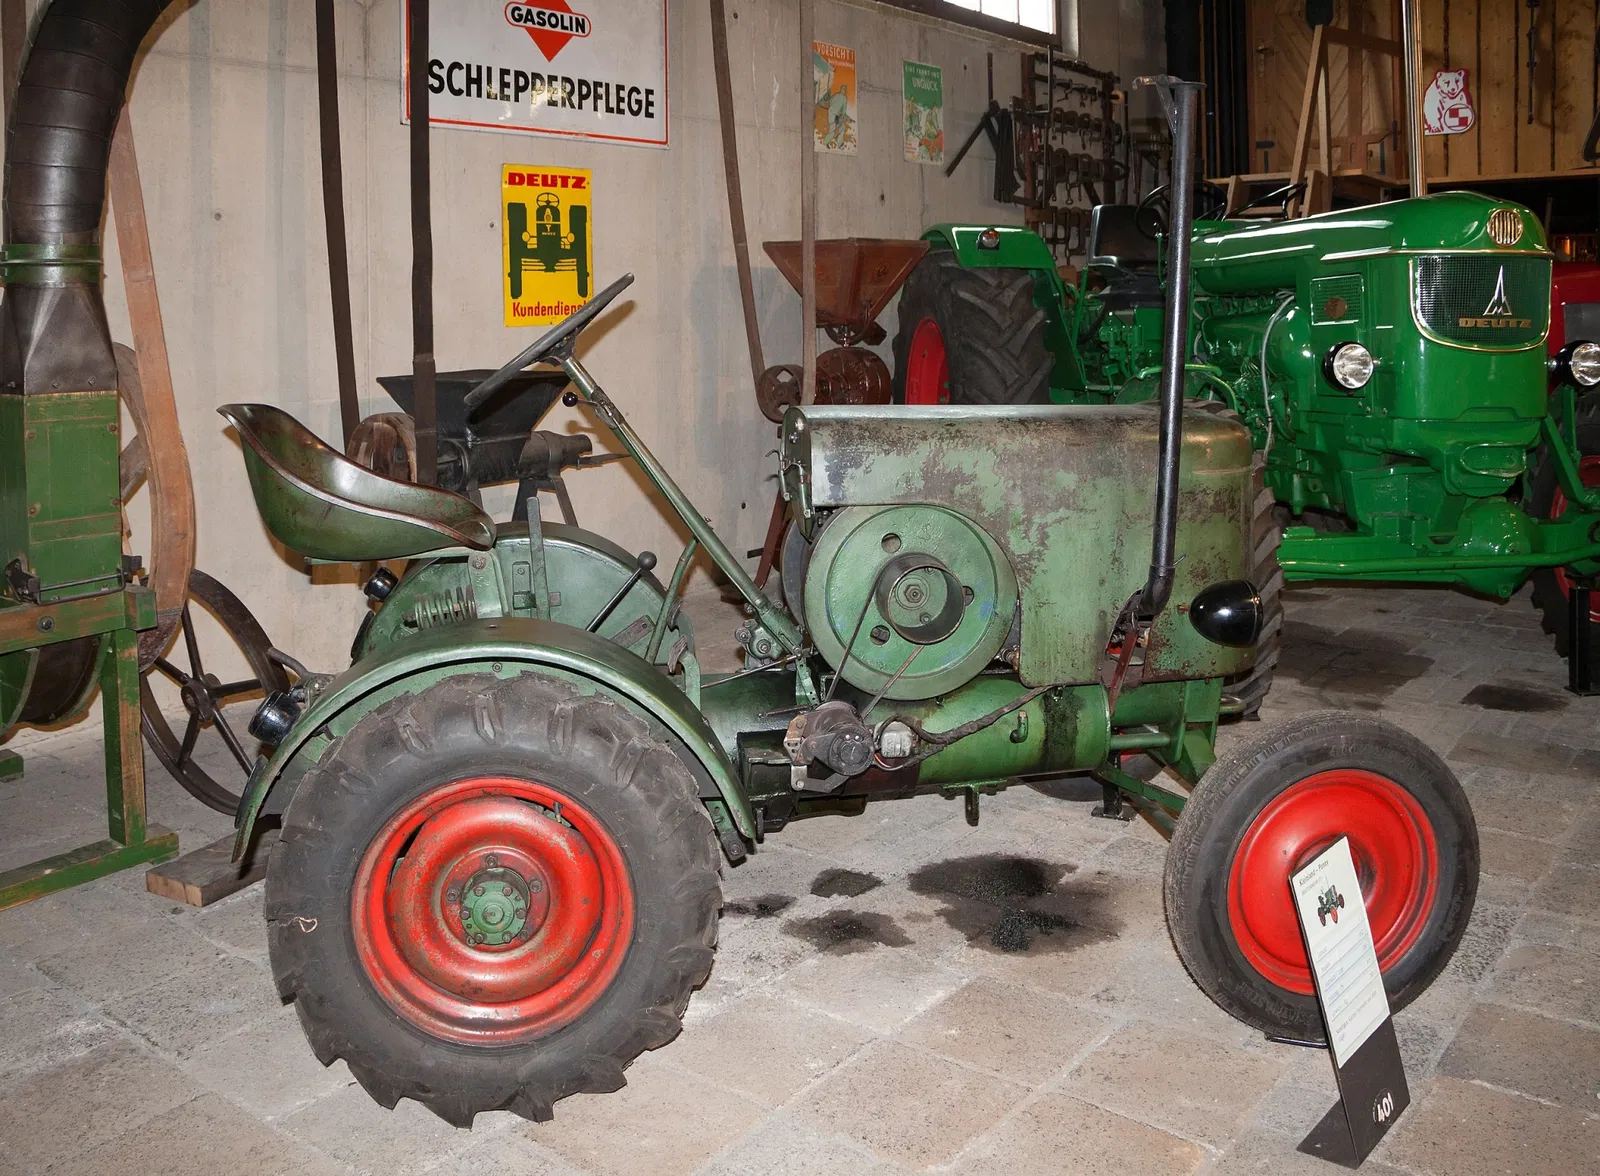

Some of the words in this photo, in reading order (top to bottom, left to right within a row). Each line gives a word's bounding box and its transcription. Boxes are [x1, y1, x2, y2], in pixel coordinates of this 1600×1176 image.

[511, 6, 586, 34] GASOLIN
[428, 59, 654, 118] SCHLEPPERPFLEGE
[508, 172, 586, 189] DEUTZ
[1459, 318, 1532, 328] DEUTZ
[1377, 1092, 1394, 1122] 401
